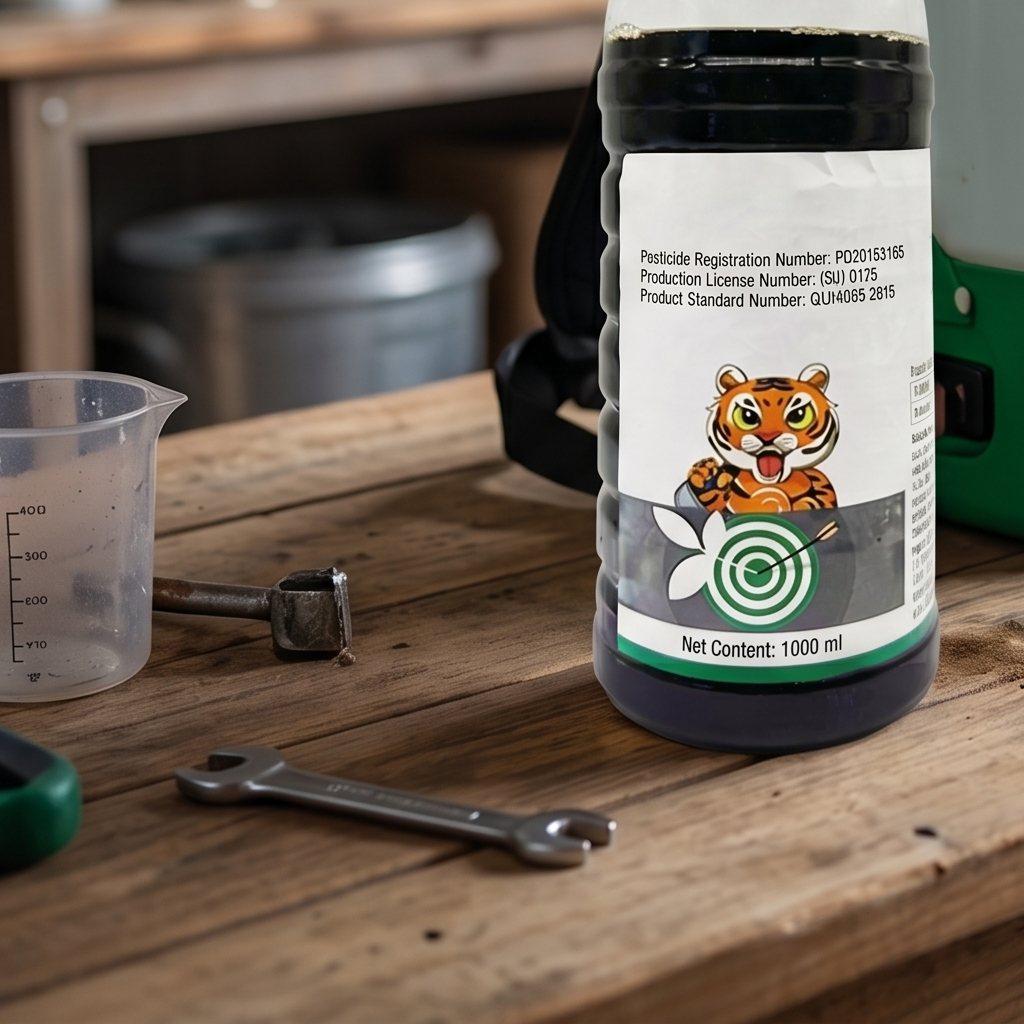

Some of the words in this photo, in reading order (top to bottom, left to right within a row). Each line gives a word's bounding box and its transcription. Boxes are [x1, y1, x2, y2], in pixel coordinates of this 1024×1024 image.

[640, 249, 691, 266] Pesticide
[694, 251, 771, 270] Registration
[775, 251, 831, 267] Number:
[640, 268, 702, 287] Production
[706, 272, 755, 288] License
[759, 272, 816, 288] Number:
[640, 288, 684, 306] Product
[687, 291, 744, 308] Standard
[749, 292, 806, 308] Number:
[869, 284, 896, 301] 2815
[24, 550, 48, 562] 300
[682, 635, 707, 655] Net
[711, 639, 776, 659] Content:
[781, 637, 819, 657] 1000
[824, 633, 843, 653] ml
